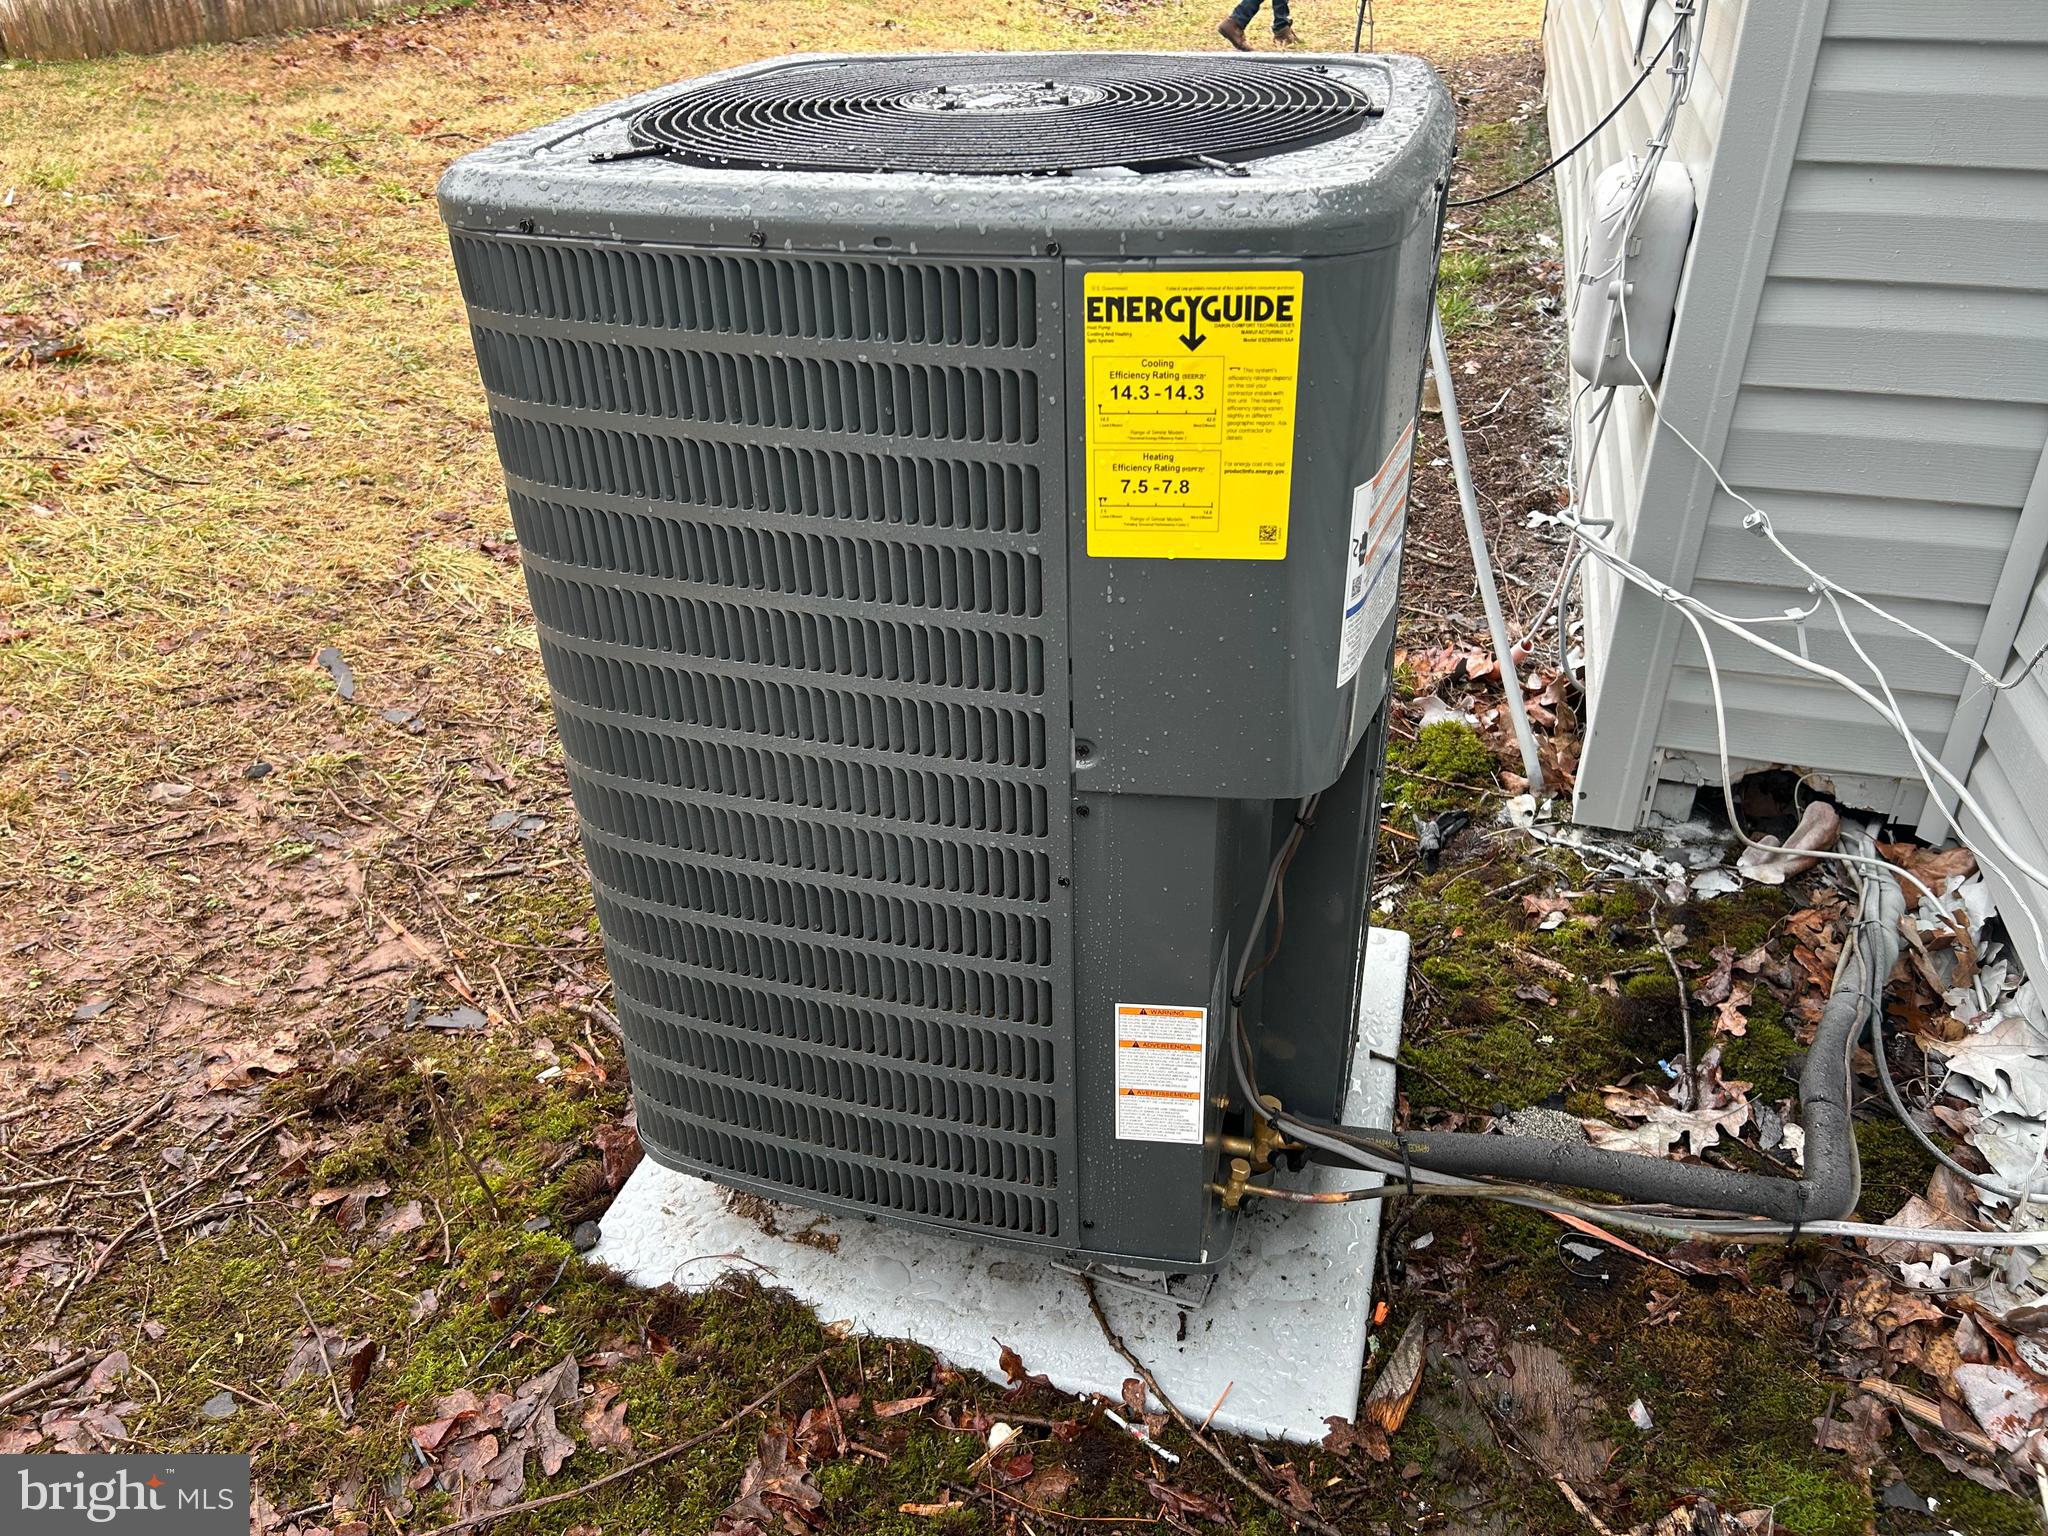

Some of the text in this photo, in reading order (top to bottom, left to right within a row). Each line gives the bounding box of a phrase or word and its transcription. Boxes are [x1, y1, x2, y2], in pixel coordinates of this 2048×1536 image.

[1087, 294, 1295, 323] ENERGYGUIDE
[1141, 359, 1174, 369] Cooling
[1110, 371, 1150, 380] Efficiency
[1152, 371, 1180, 381] Rating
[1143, 453, 1174, 462] Heating
[1112, 464, 1152, 473] Efficiency
[1154, 464, 1180, 473] Rating
